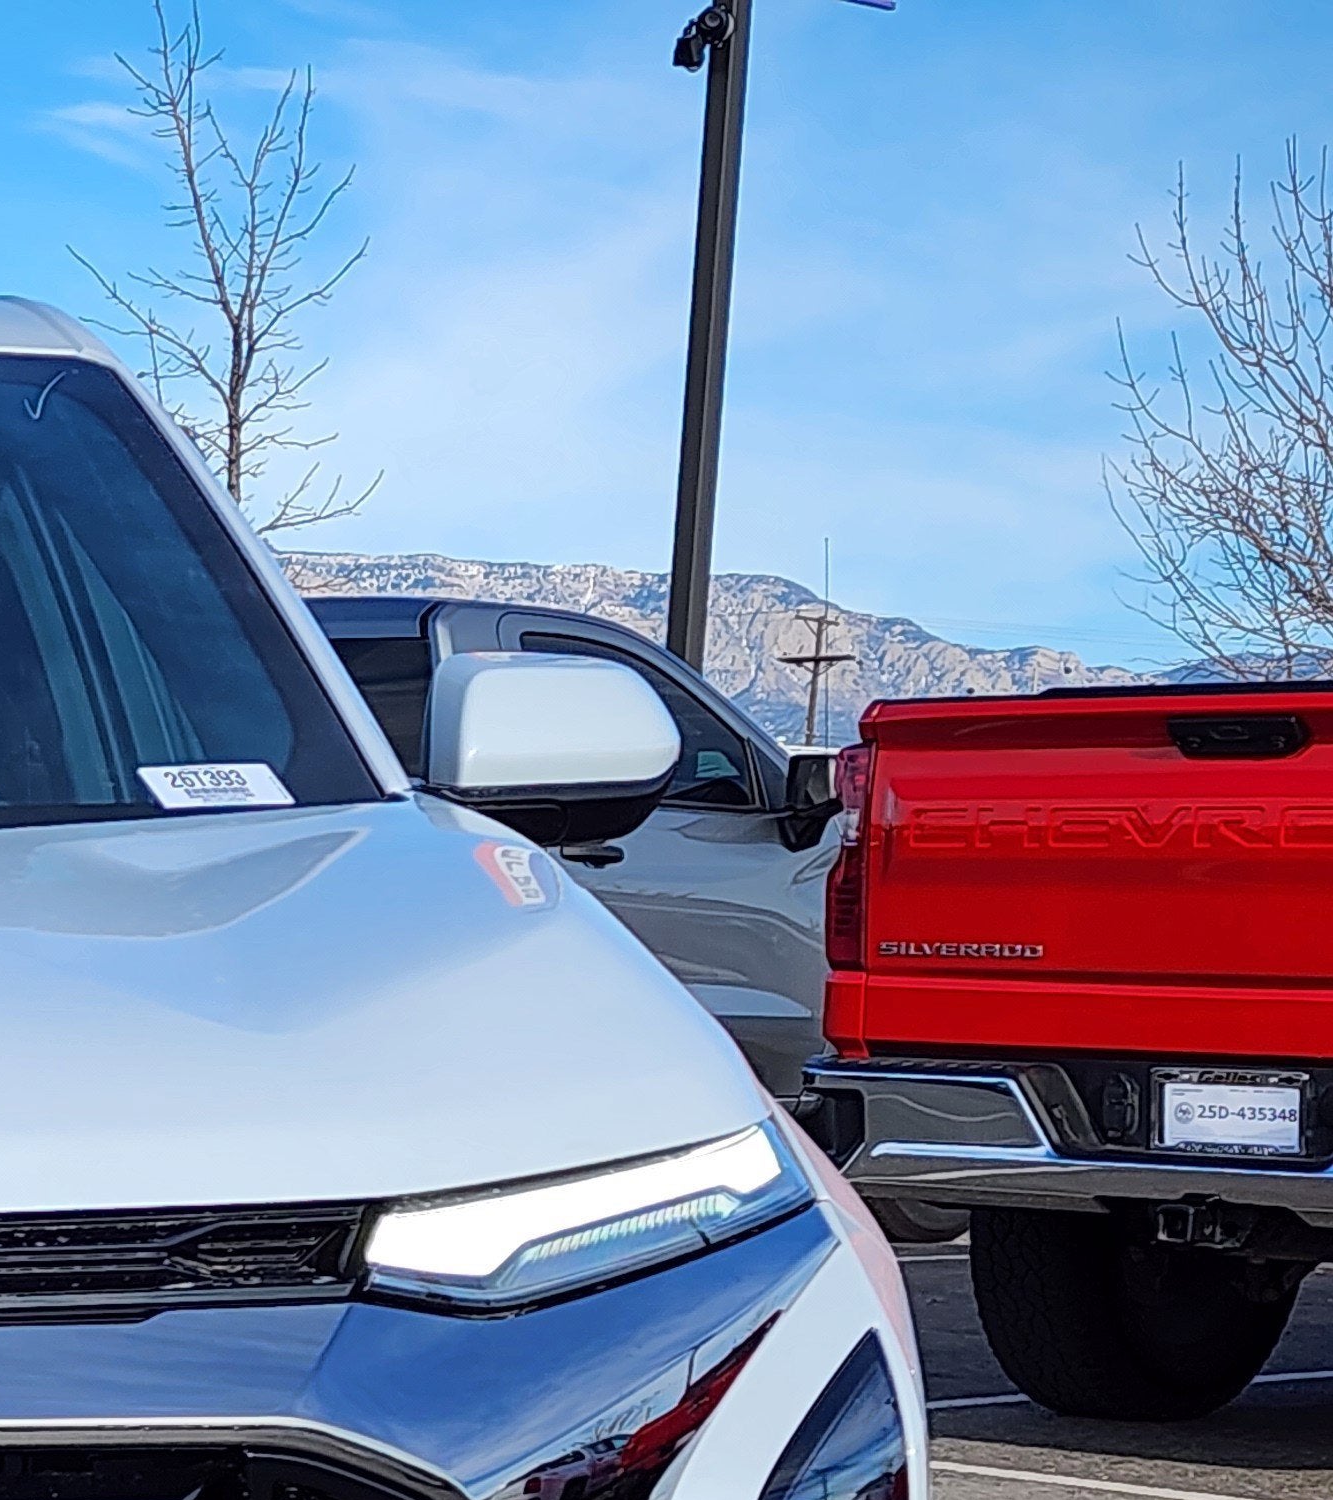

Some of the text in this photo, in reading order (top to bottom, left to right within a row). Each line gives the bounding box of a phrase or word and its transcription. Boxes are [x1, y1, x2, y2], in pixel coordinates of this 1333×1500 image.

[163, 769, 247, 788] 26T393
[878, 941, 1044, 958] SILVERADO
[1197, 1104, 1298, 1122] 25D-435348
